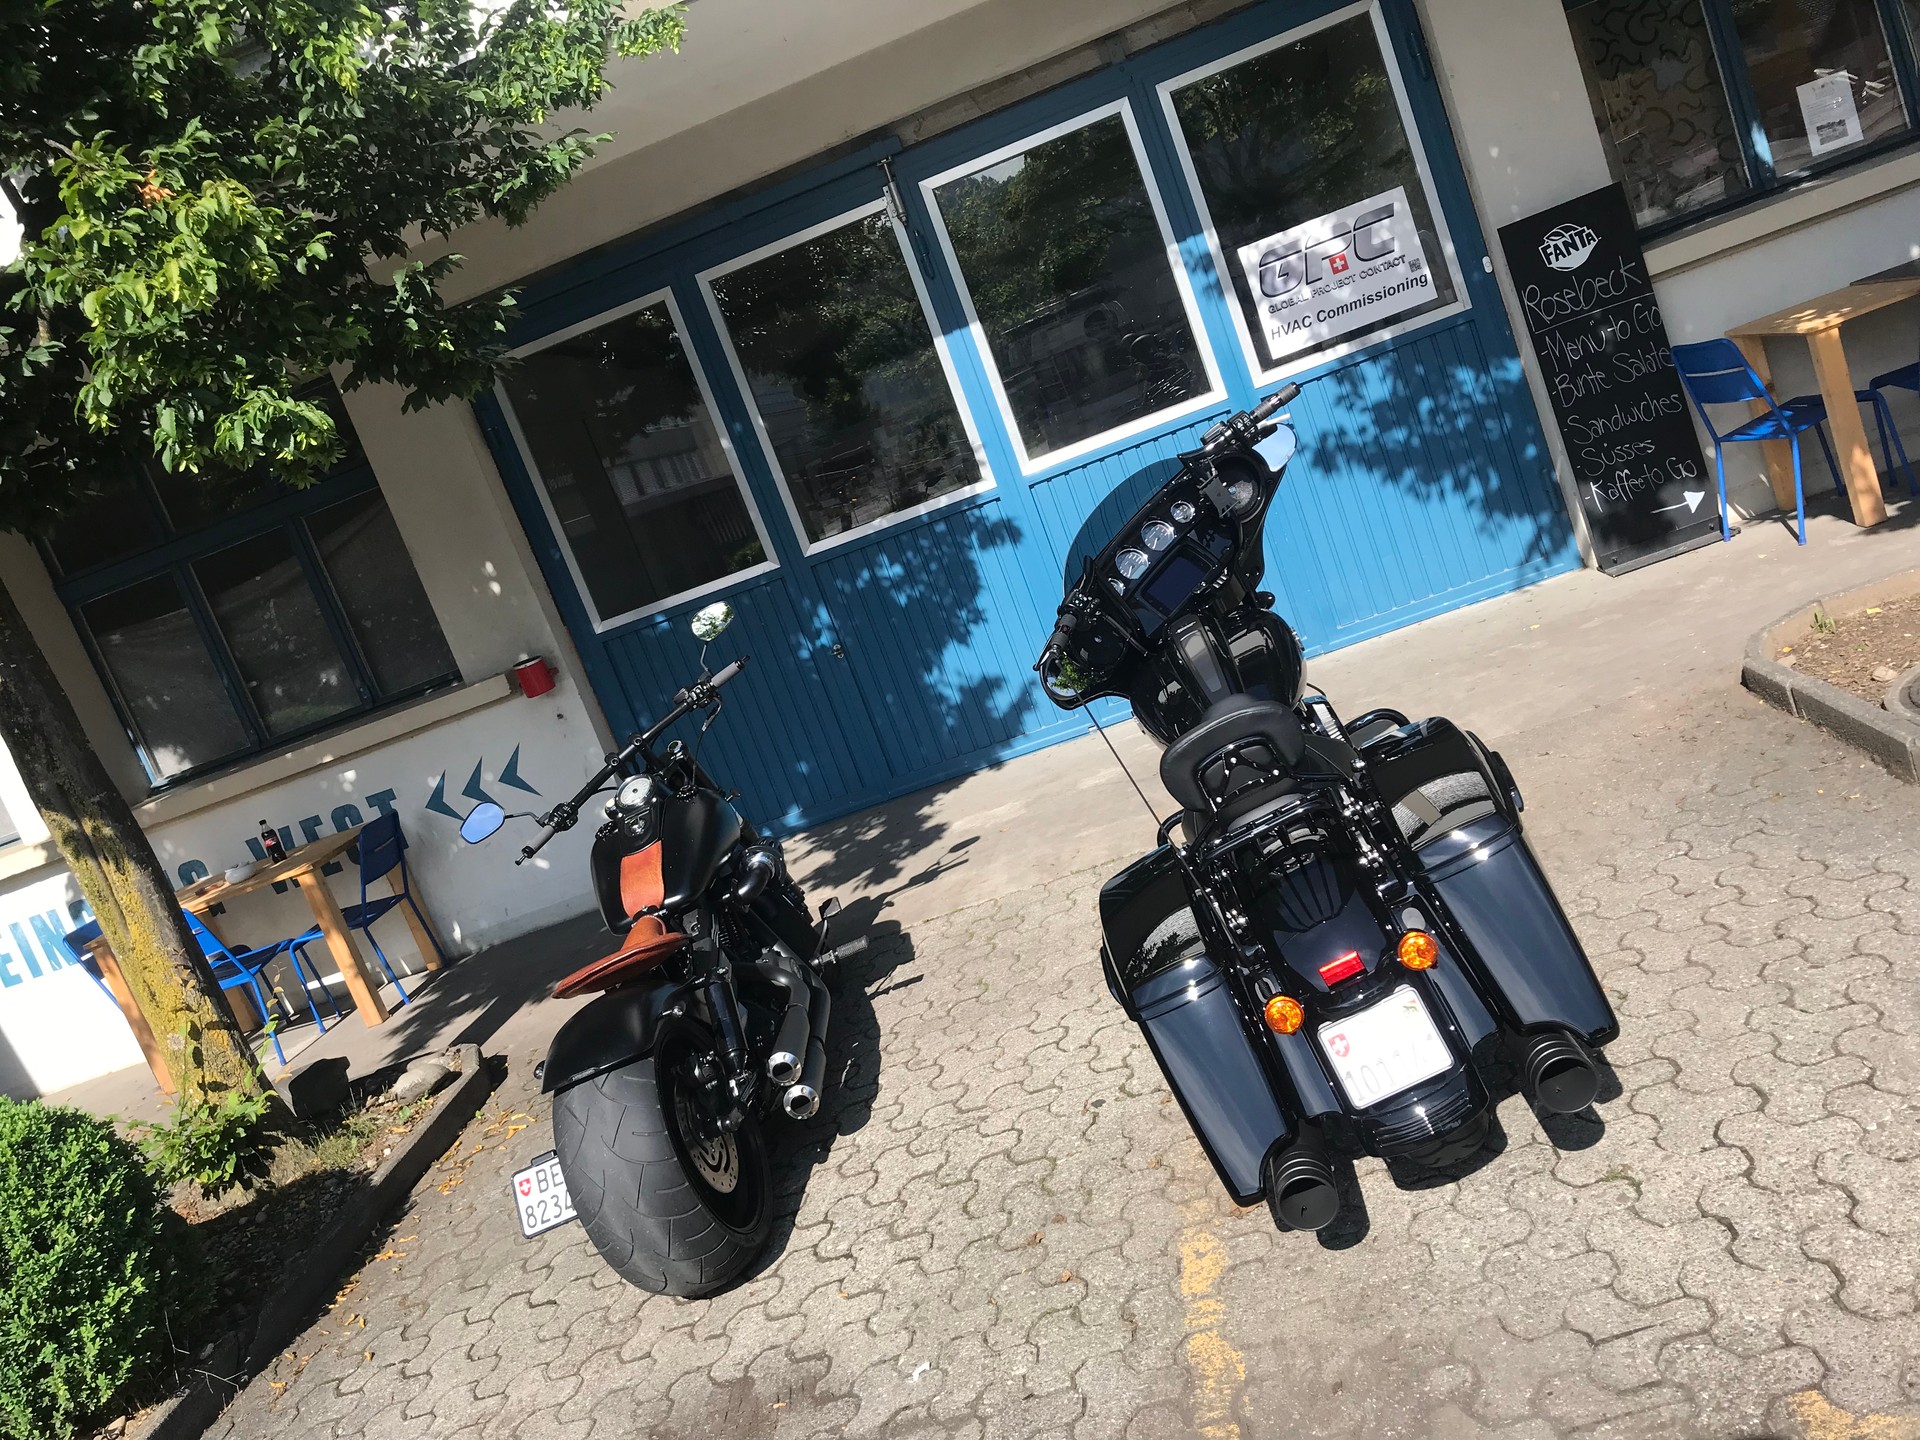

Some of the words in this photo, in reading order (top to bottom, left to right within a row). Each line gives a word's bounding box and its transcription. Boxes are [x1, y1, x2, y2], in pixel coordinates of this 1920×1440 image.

[1259, 202, 1395, 298] GPC
[1540, 228, 1597, 266] FANTA
[1311, 274, 1356, 298] PROJECT
[1359, 254, 1406, 279] CONTACT
[1271, 315, 1312, 340] HVAC
[1316, 274, 1428, 323] Commissioning
[1633, 303, 1662, 334] Go
[1613, 341, 1675, 383] Salate
[1666, 457, 1697, 480] Go
[536, 1162, 564, 1193] BE
